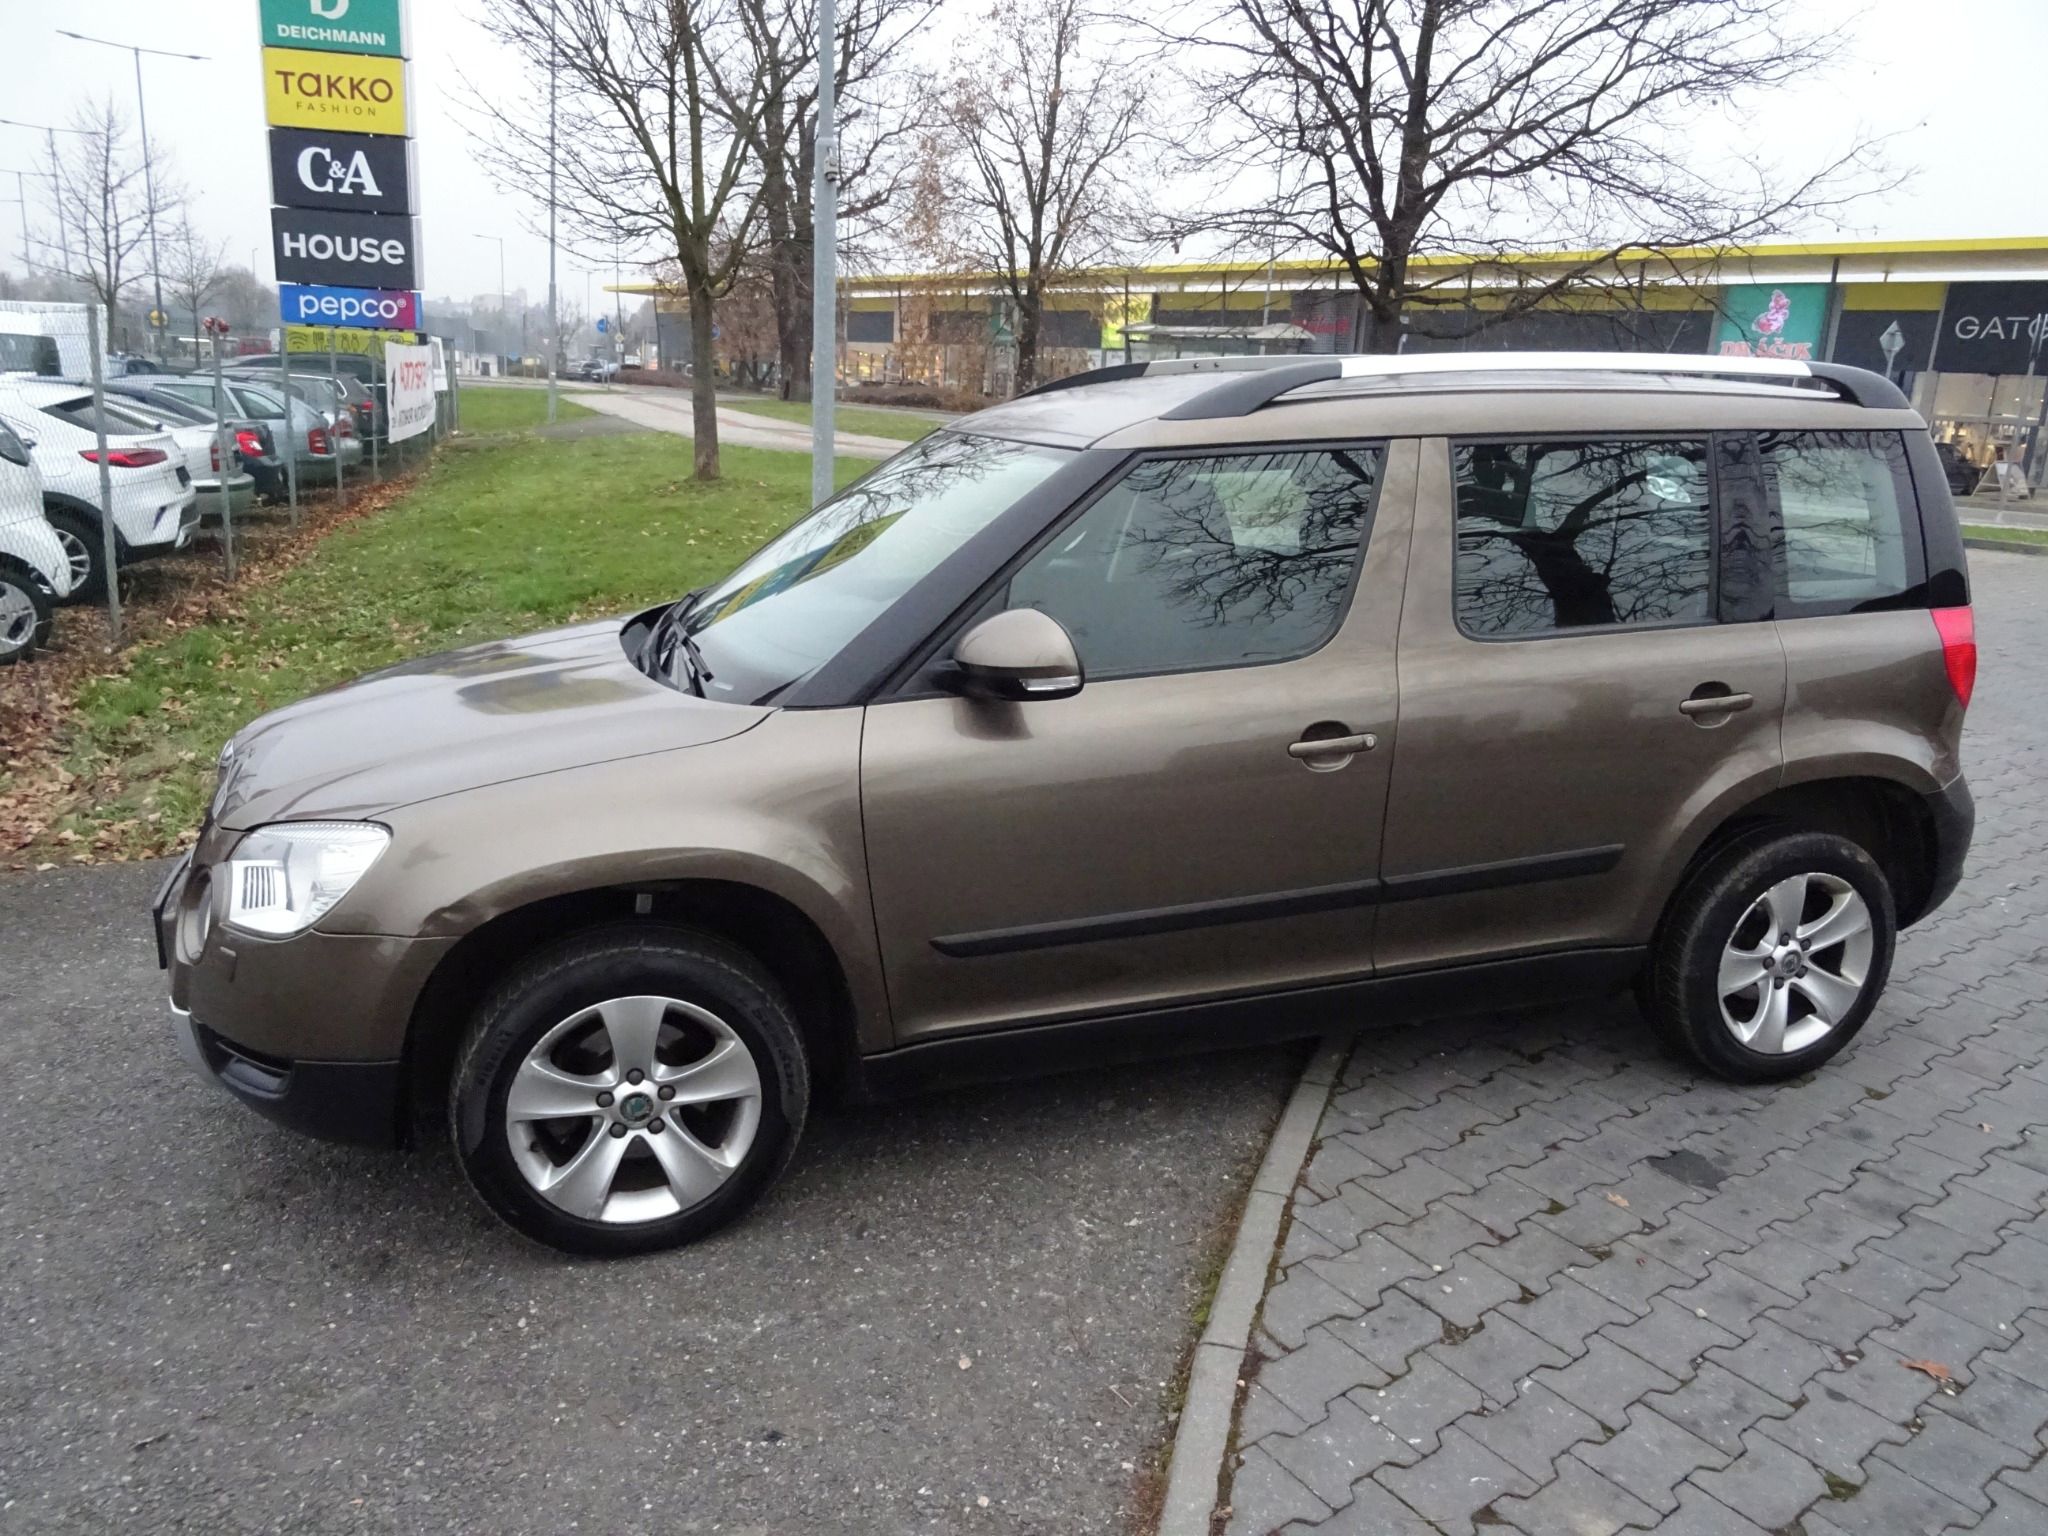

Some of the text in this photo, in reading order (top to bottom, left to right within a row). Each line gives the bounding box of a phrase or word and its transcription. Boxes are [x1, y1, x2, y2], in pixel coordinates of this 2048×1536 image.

[277, 24, 386, 46] DEICHMANN
[296, 101, 376, 116] FASHION
[297, 147, 383, 196] C&A
